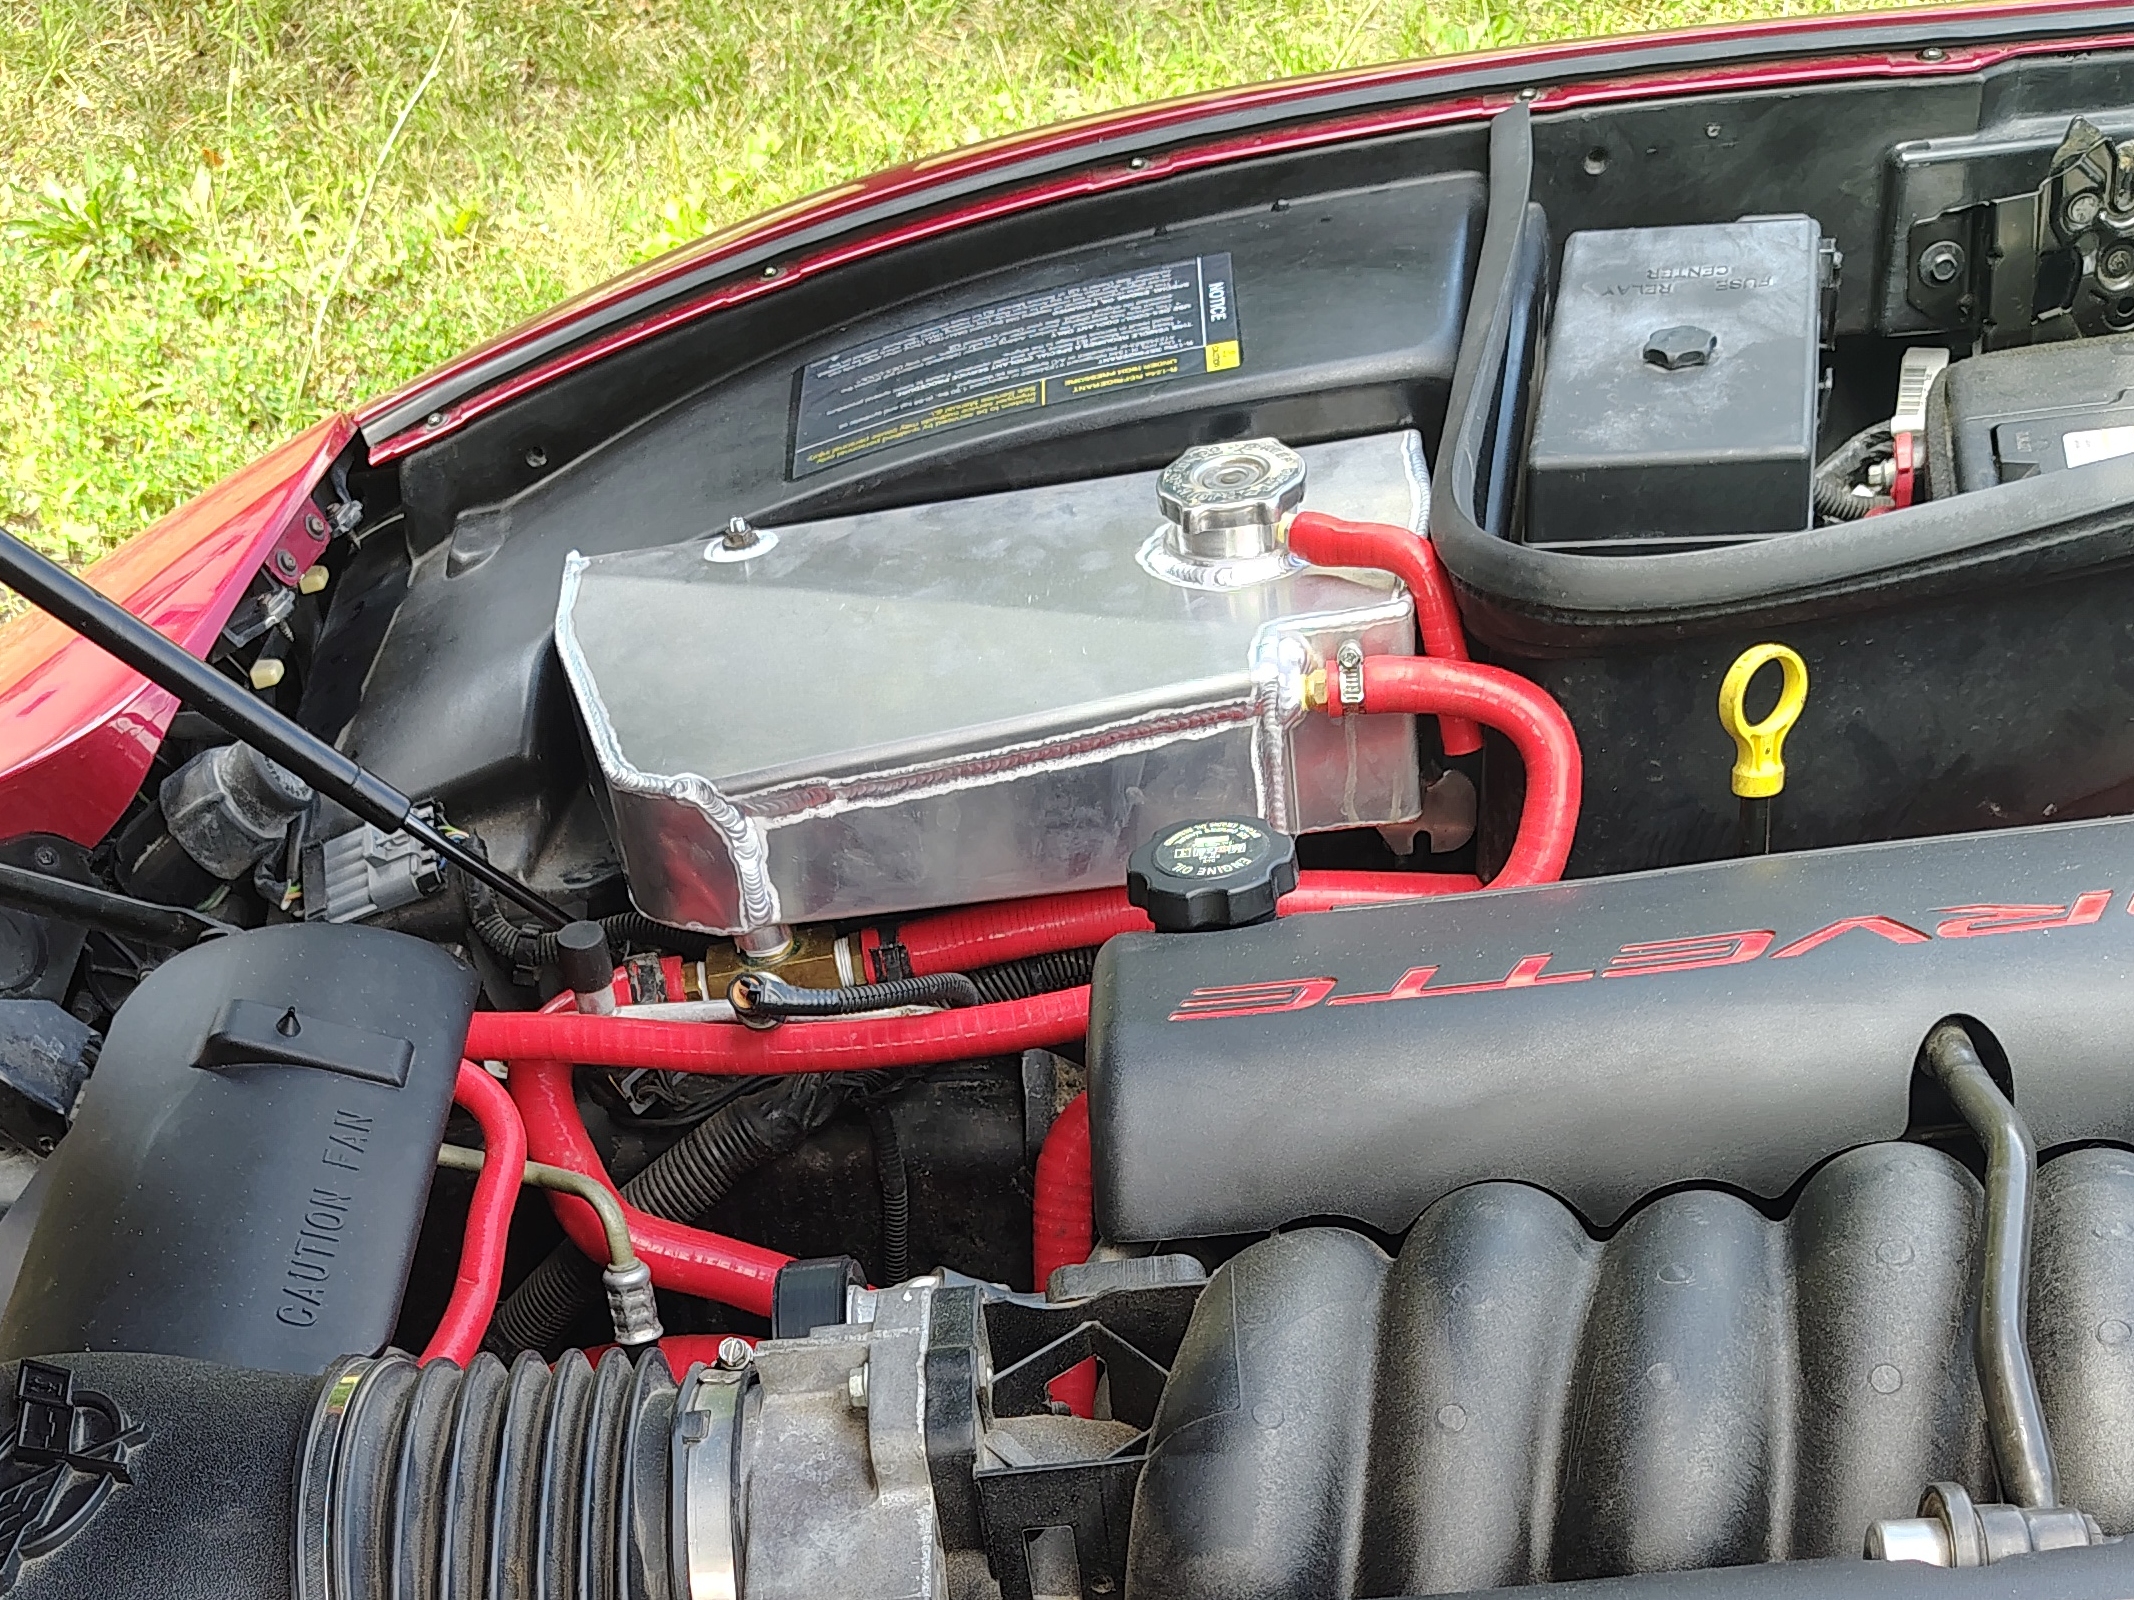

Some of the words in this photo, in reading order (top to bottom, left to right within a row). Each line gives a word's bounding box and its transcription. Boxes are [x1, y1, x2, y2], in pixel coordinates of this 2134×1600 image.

[1646, 265, 1729, 280] CENTER
[1602, 283, 1673, 296] RELAY
[1716, 276, 1774, 292] FUSE
[1208, 281, 1228, 323] NOTICE
[1143, 357, 1177, 370] UNDER
[1071, 372, 1142, 393] REFRIGERANT
[1172, 863, 1194, 875] OIL
[1196, 857, 1252, 875] ENGINE
[1168, 889, 2134, 1022] RVETTE
[276, 1188, 352, 1328] CAUTION
[322, 1109, 373, 1171] FAN
